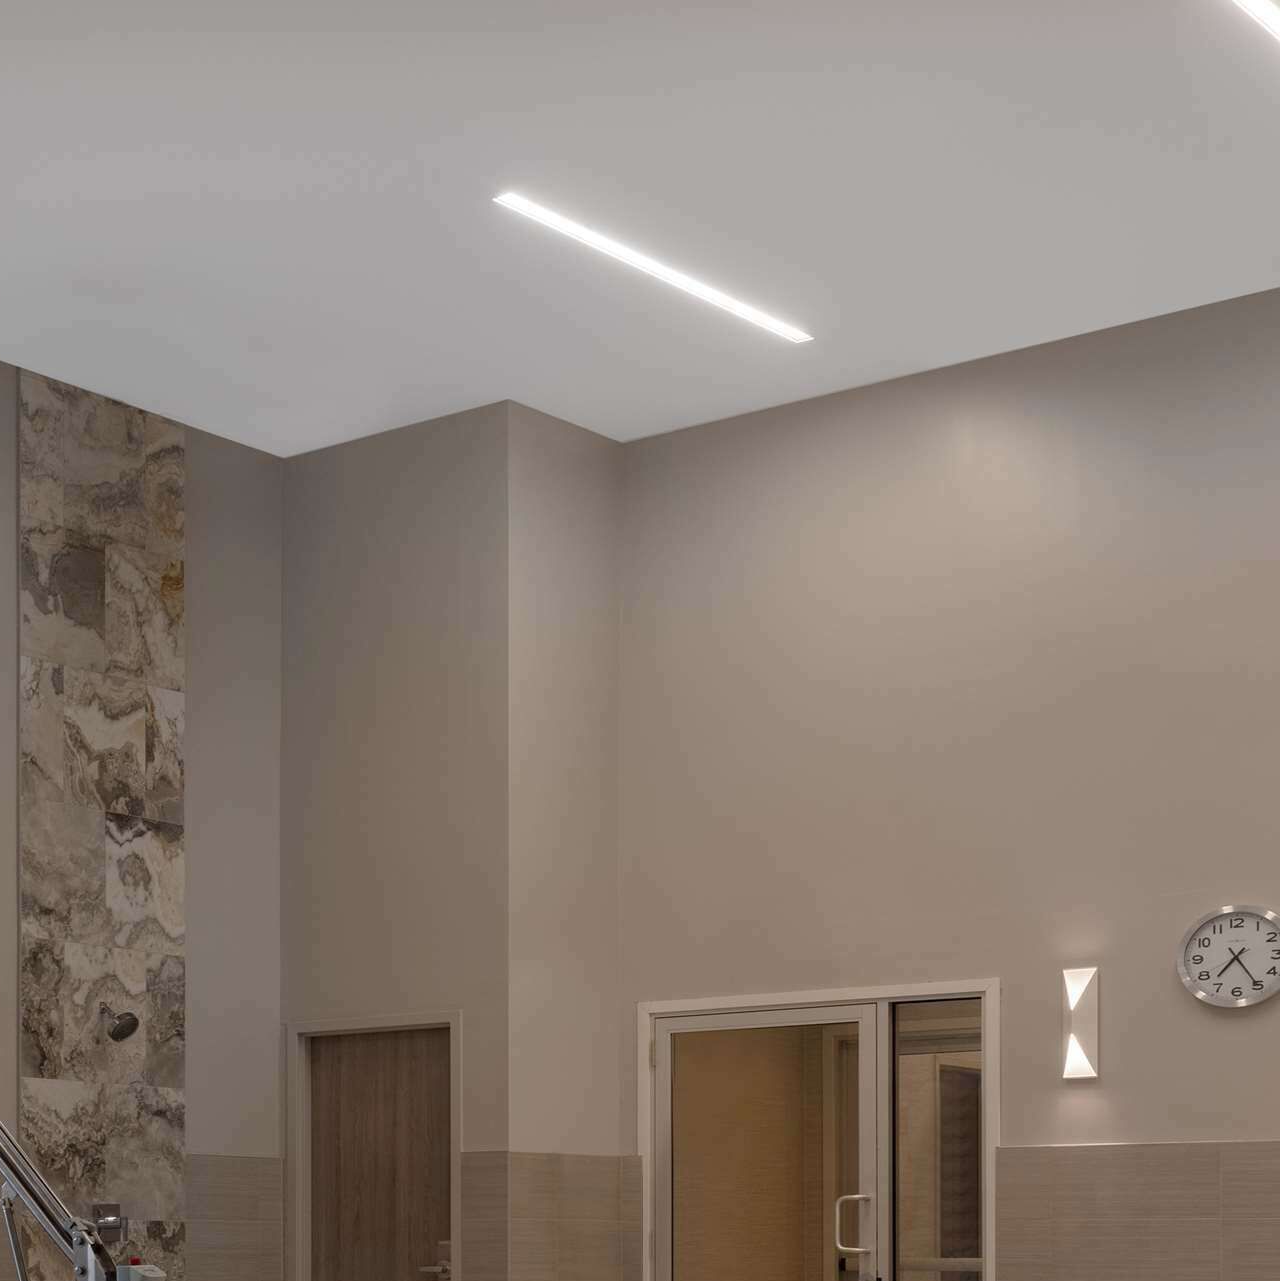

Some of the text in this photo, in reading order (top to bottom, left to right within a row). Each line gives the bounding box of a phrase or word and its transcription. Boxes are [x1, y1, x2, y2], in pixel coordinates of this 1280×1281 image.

[1230, 918, 1245, 929] 12
[1213, 924, 1223, 934] 11
[1265, 932, 1278, 942] 2
[1198, 937, 1211, 948] 10
[1192, 954, 1204, 965] 9
[1198, 971, 1210, 981] 8
[1266, 966, 1278, 976] 4
[1213, 982, 1223, 993] 7
[1252, 980, 1264, 990] 5
[1231, 987, 1243, 997] 6
